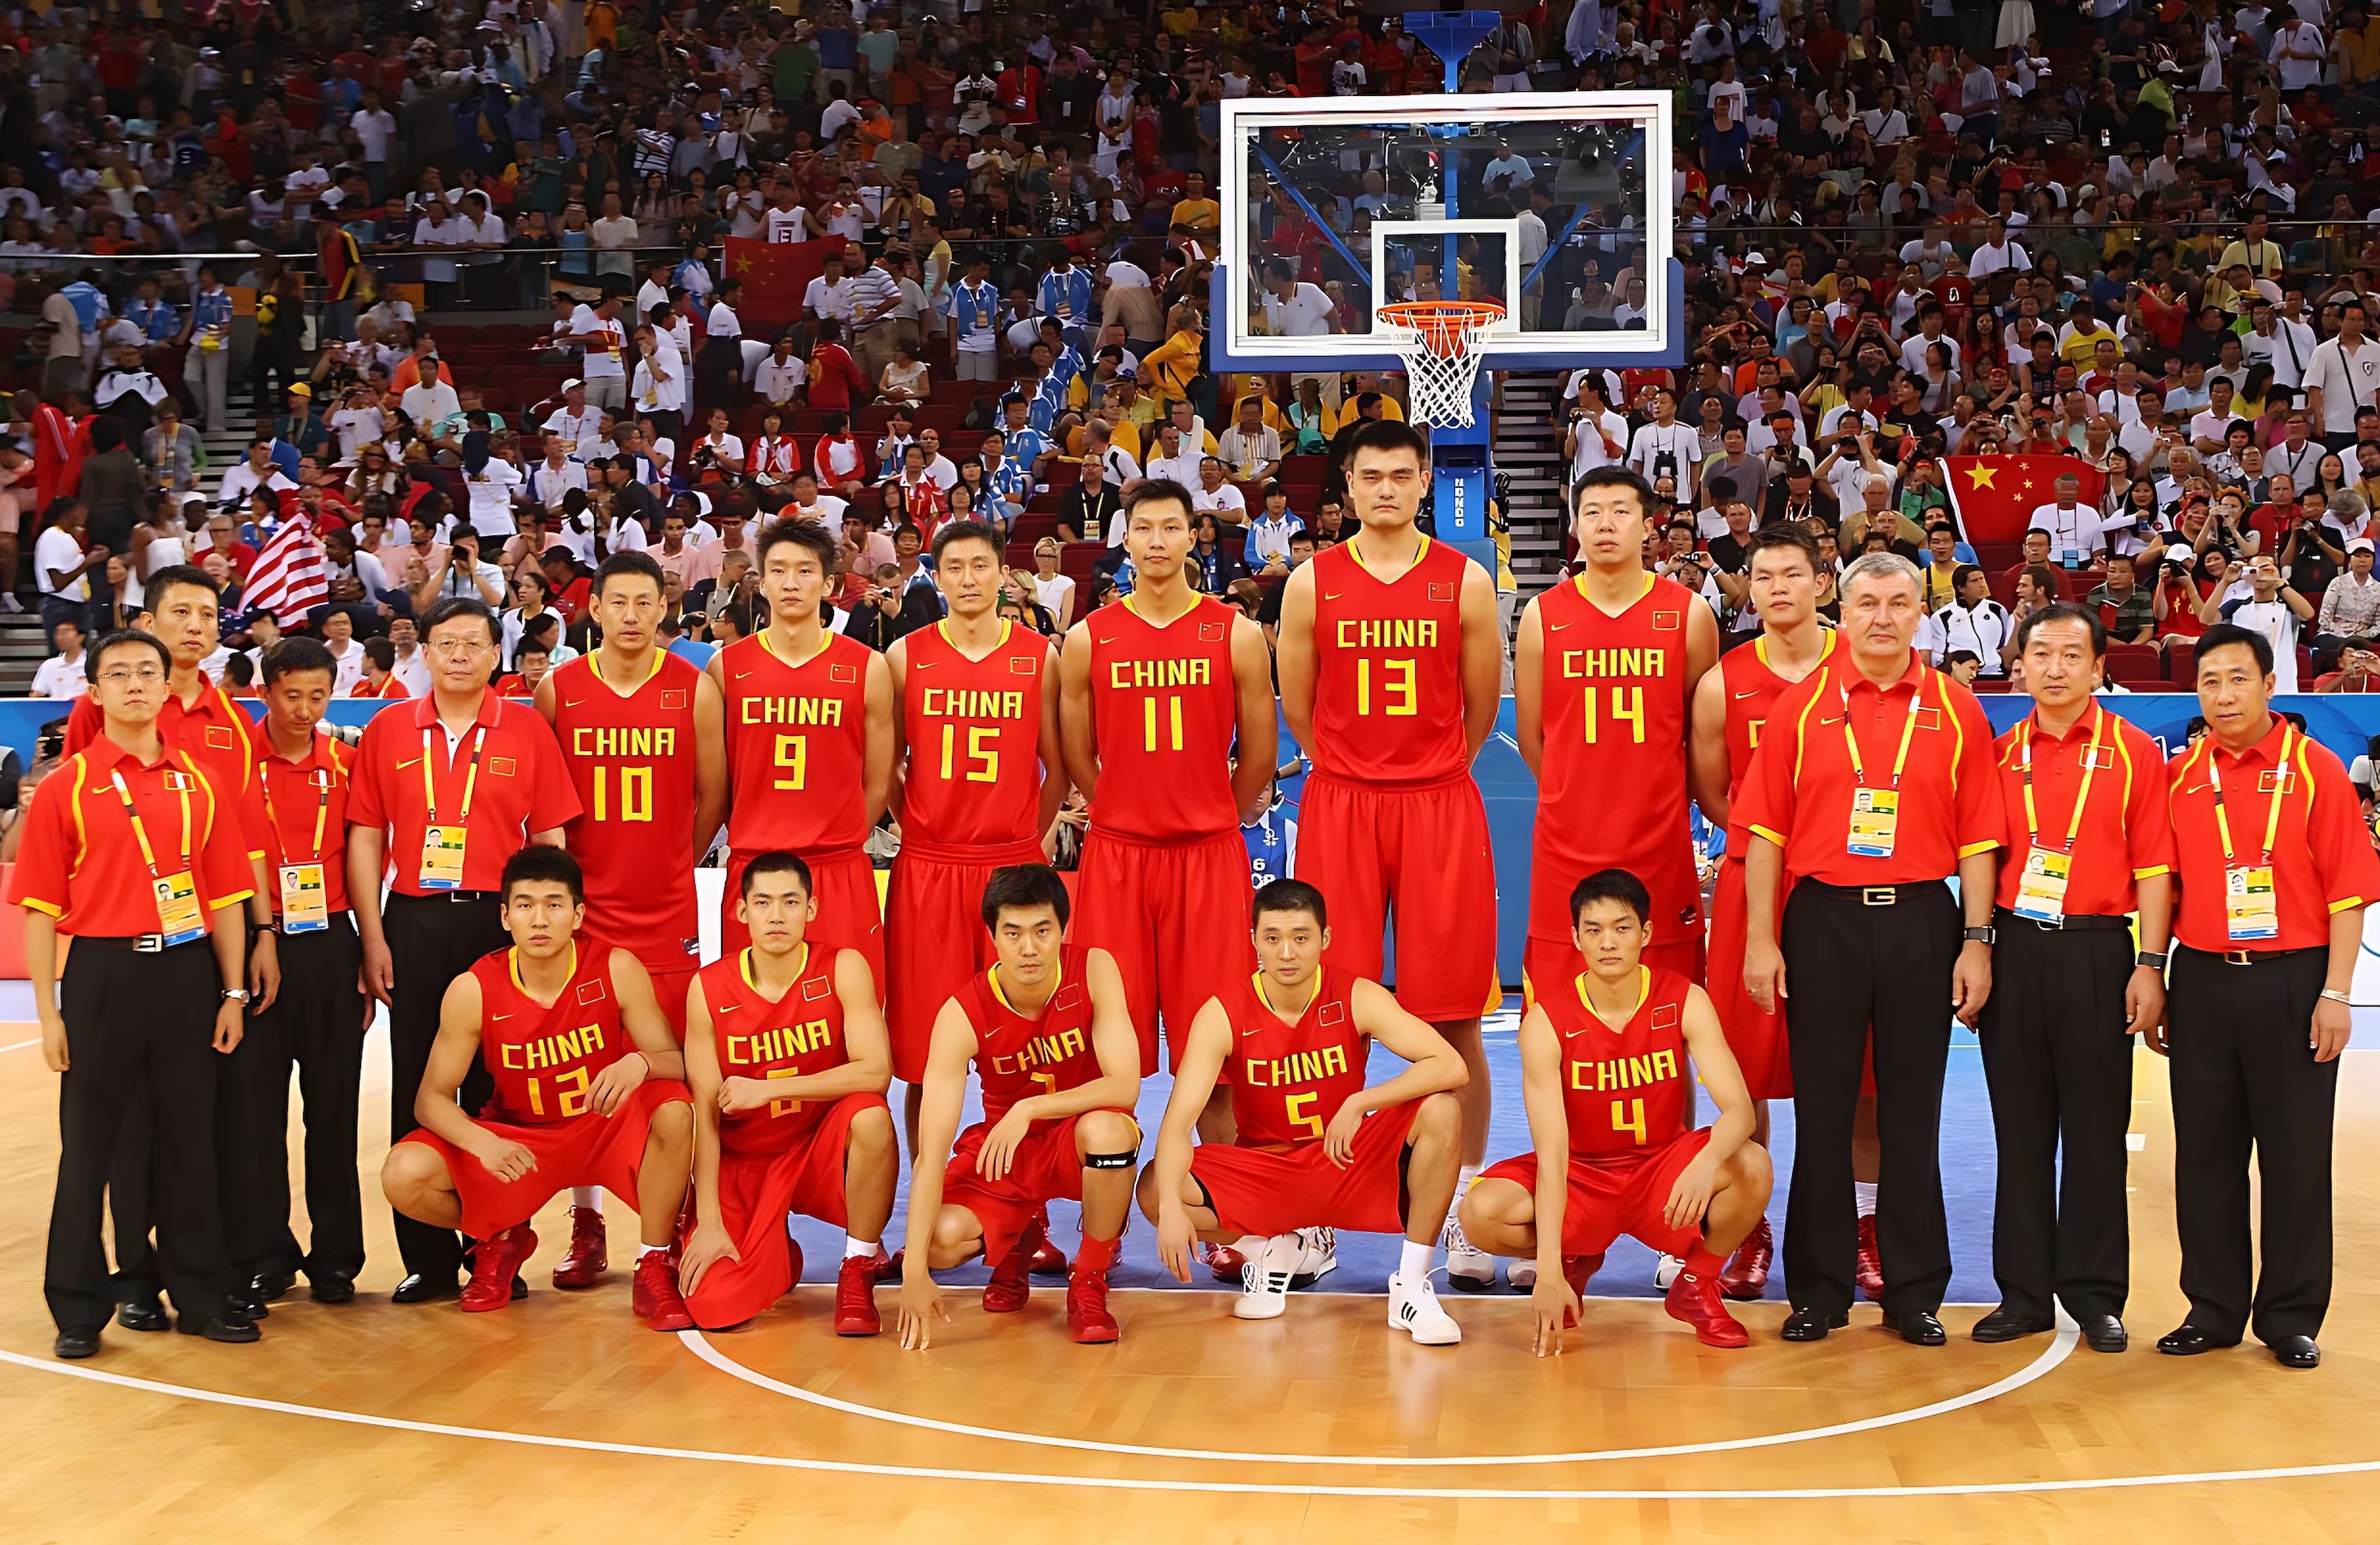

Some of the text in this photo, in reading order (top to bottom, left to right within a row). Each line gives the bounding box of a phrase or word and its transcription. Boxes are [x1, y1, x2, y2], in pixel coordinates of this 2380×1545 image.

[1454, 477, 1464, 527] MONDO
[1337, 619, 1438, 648] CHINA
[1111, 657, 1211, 689] CHINA
[1357, 658, 1418, 716] 13
[1562, 648, 1664, 678] CHINA
[742, 696, 843, 727] CHINA
[923, 688, 1023, 719] CHINA
[1144, 696, 1184, 752] 11
[1584, 686, 1645, 744] 14
[573, 727, 675, 757] CHINA
[774, 734, 807, 791] 9
[940, 723, 1000, 783] 15
[593, 765, 653, 822] 10
[501, 1022, 605, 1070] CHINA
[727, 1018, 831, 1064] CHINA
[992, 1027, 1085, 1075] CHINA
[1246, 1044, 1348, 1087] CHINA
[1572, 1049, 1678, 1091] CHINA
[527, 1065, 590, 1118] 12
[1285, 1091, 1325, 1141] 5
[1610, 1098, 1647, 1144] 4
